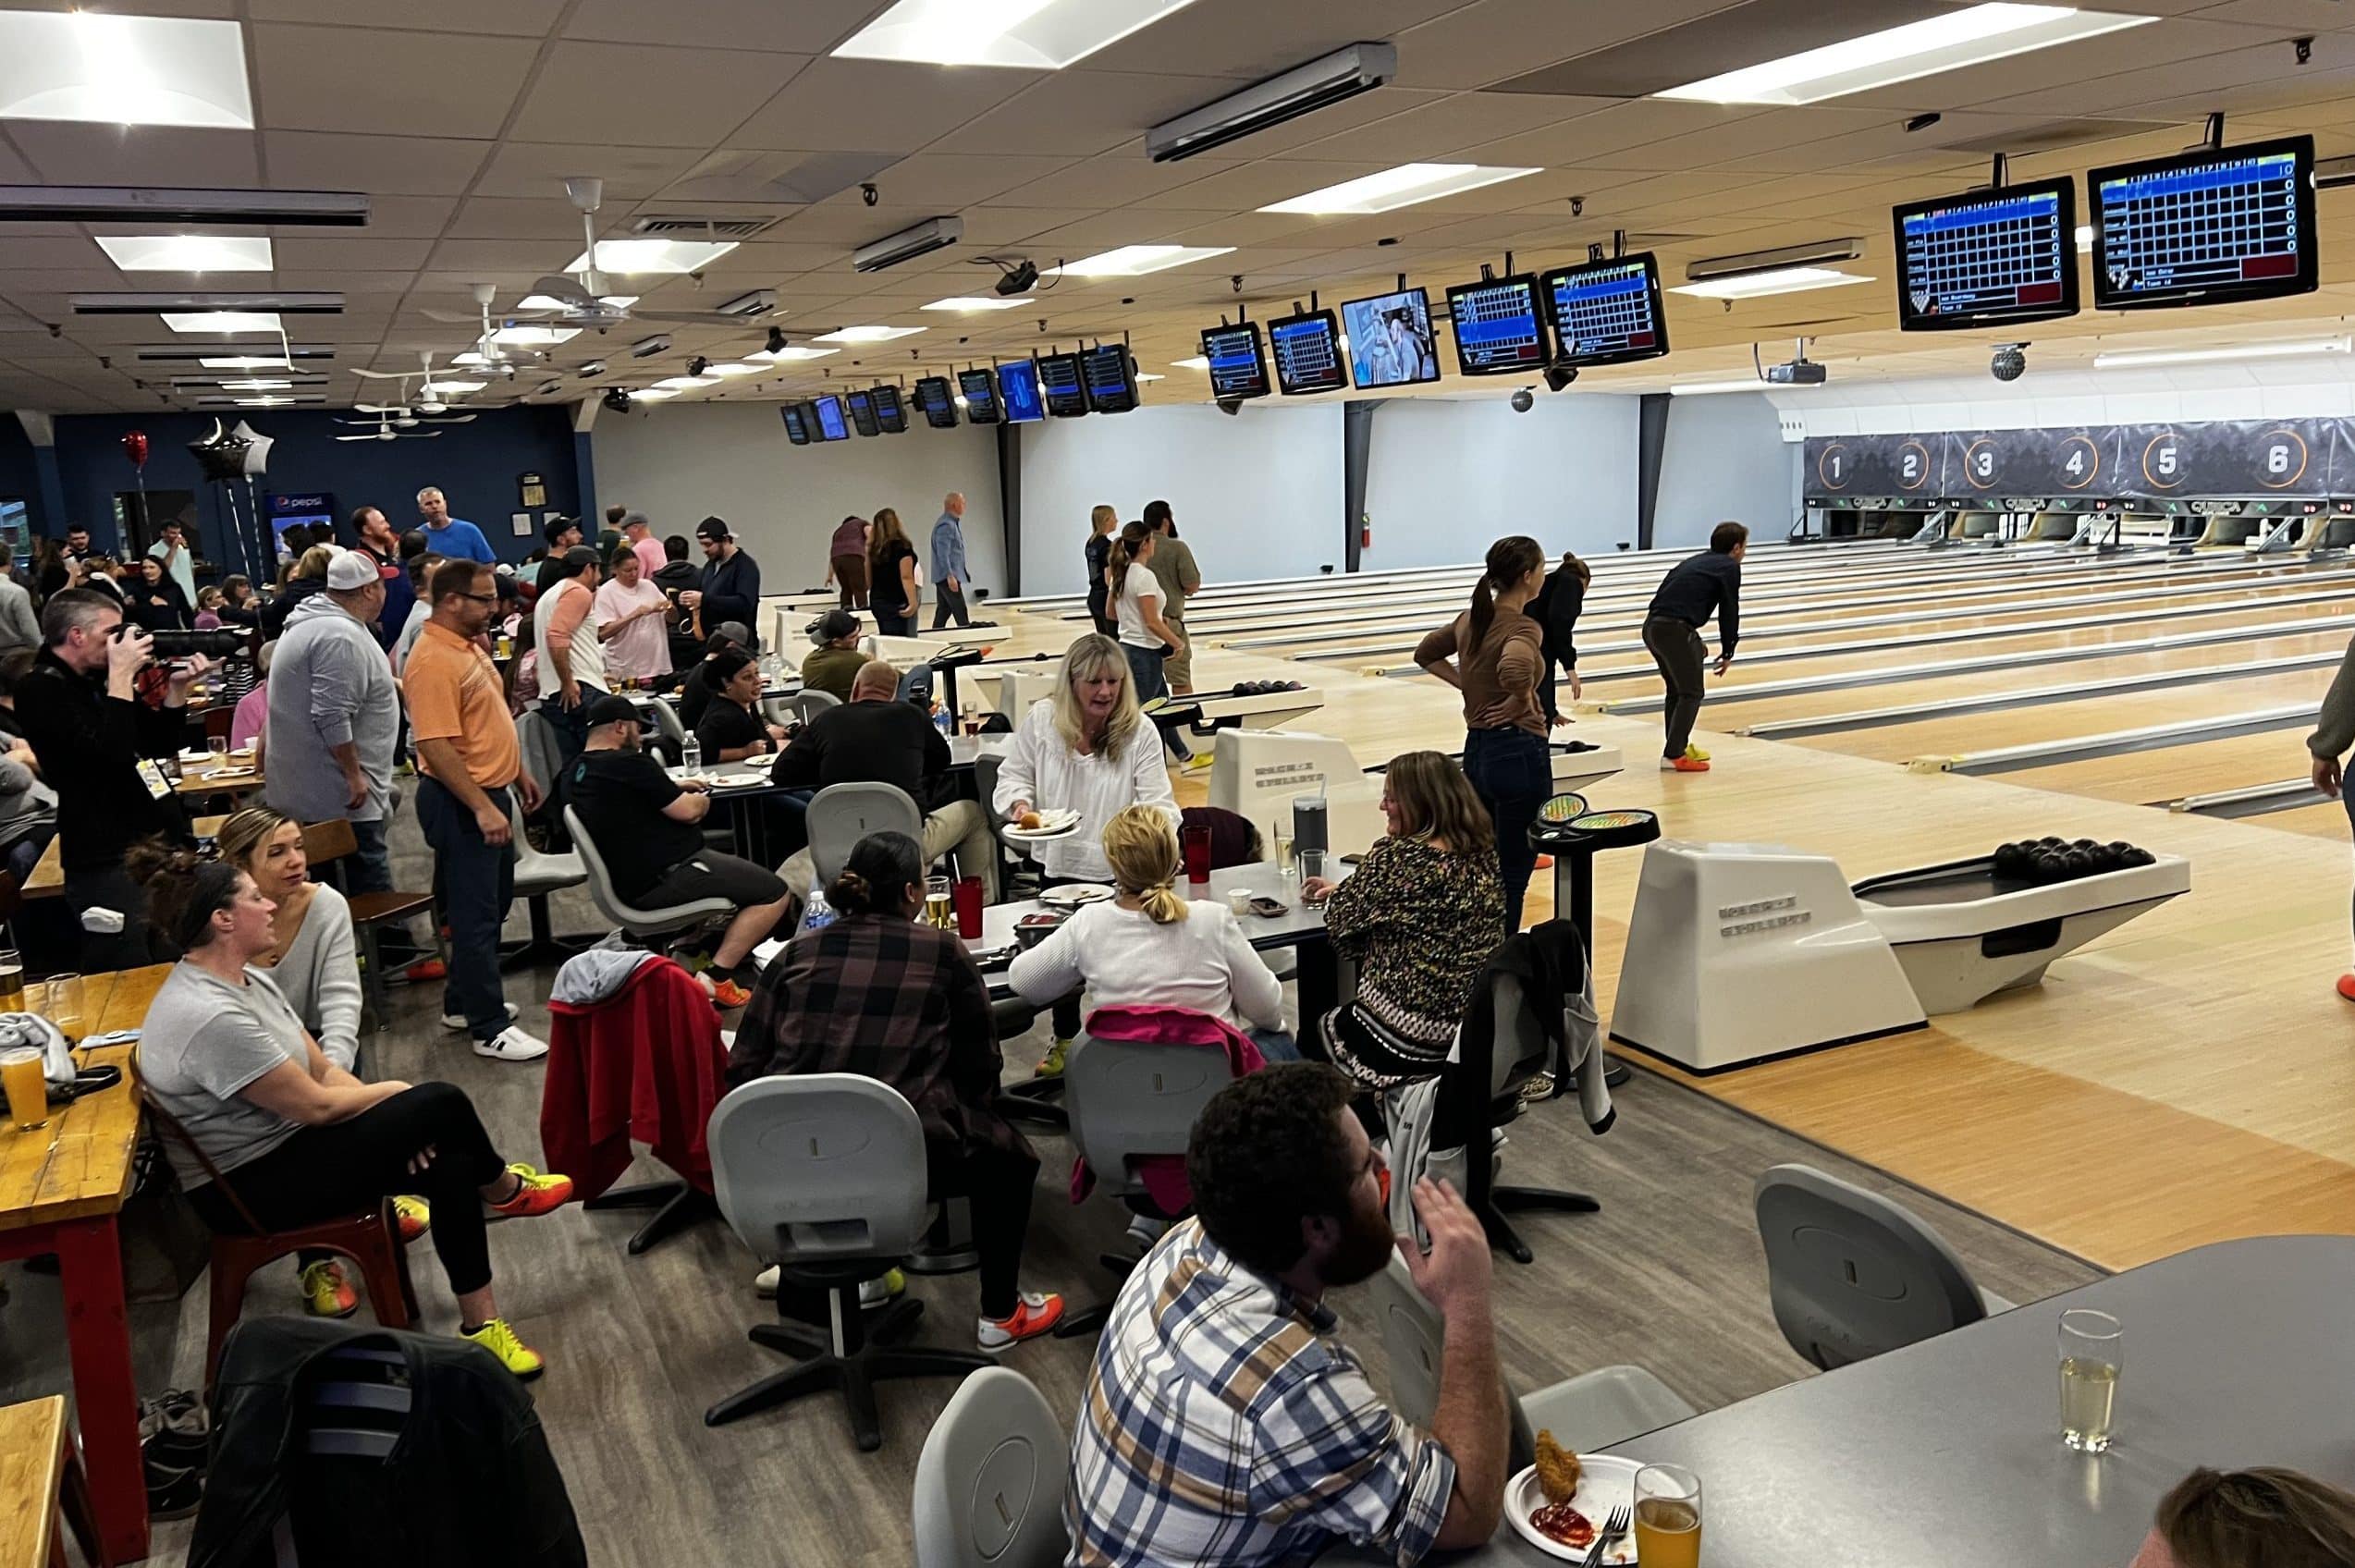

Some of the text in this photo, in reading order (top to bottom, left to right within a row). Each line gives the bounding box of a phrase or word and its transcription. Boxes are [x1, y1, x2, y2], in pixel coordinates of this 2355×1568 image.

[2279, 164, 2293, 177] 10
[2285, 178, 2294, 190] 0
[2285, 194, 2295, 206] 0
[2050, 214, 2058, 226] 0
[2286, 209, 2295, 222] 0
[2051, 228, 2058, 239] 0
[2286, 225, 2296, 237] 0
[2052, 242, 2059, 252] 0
[2287, 239, 2296, 251] 0
[1590, 245, 1602, 261] 12
[2052, 255, 2060, 266] 0
[2053, 269, 2061, 280] 0
[1977, 452, 1993, 477] 3
[2066, 449, 2084, 475] 4
[2158, 447, 2177, 474] 5
[2268, 445, 2289, 473] 6
[1833, 456, 1841, 479] 1
[1903, 454, 1918, 478] 2
[291, 496, 323, 508] pepsi
